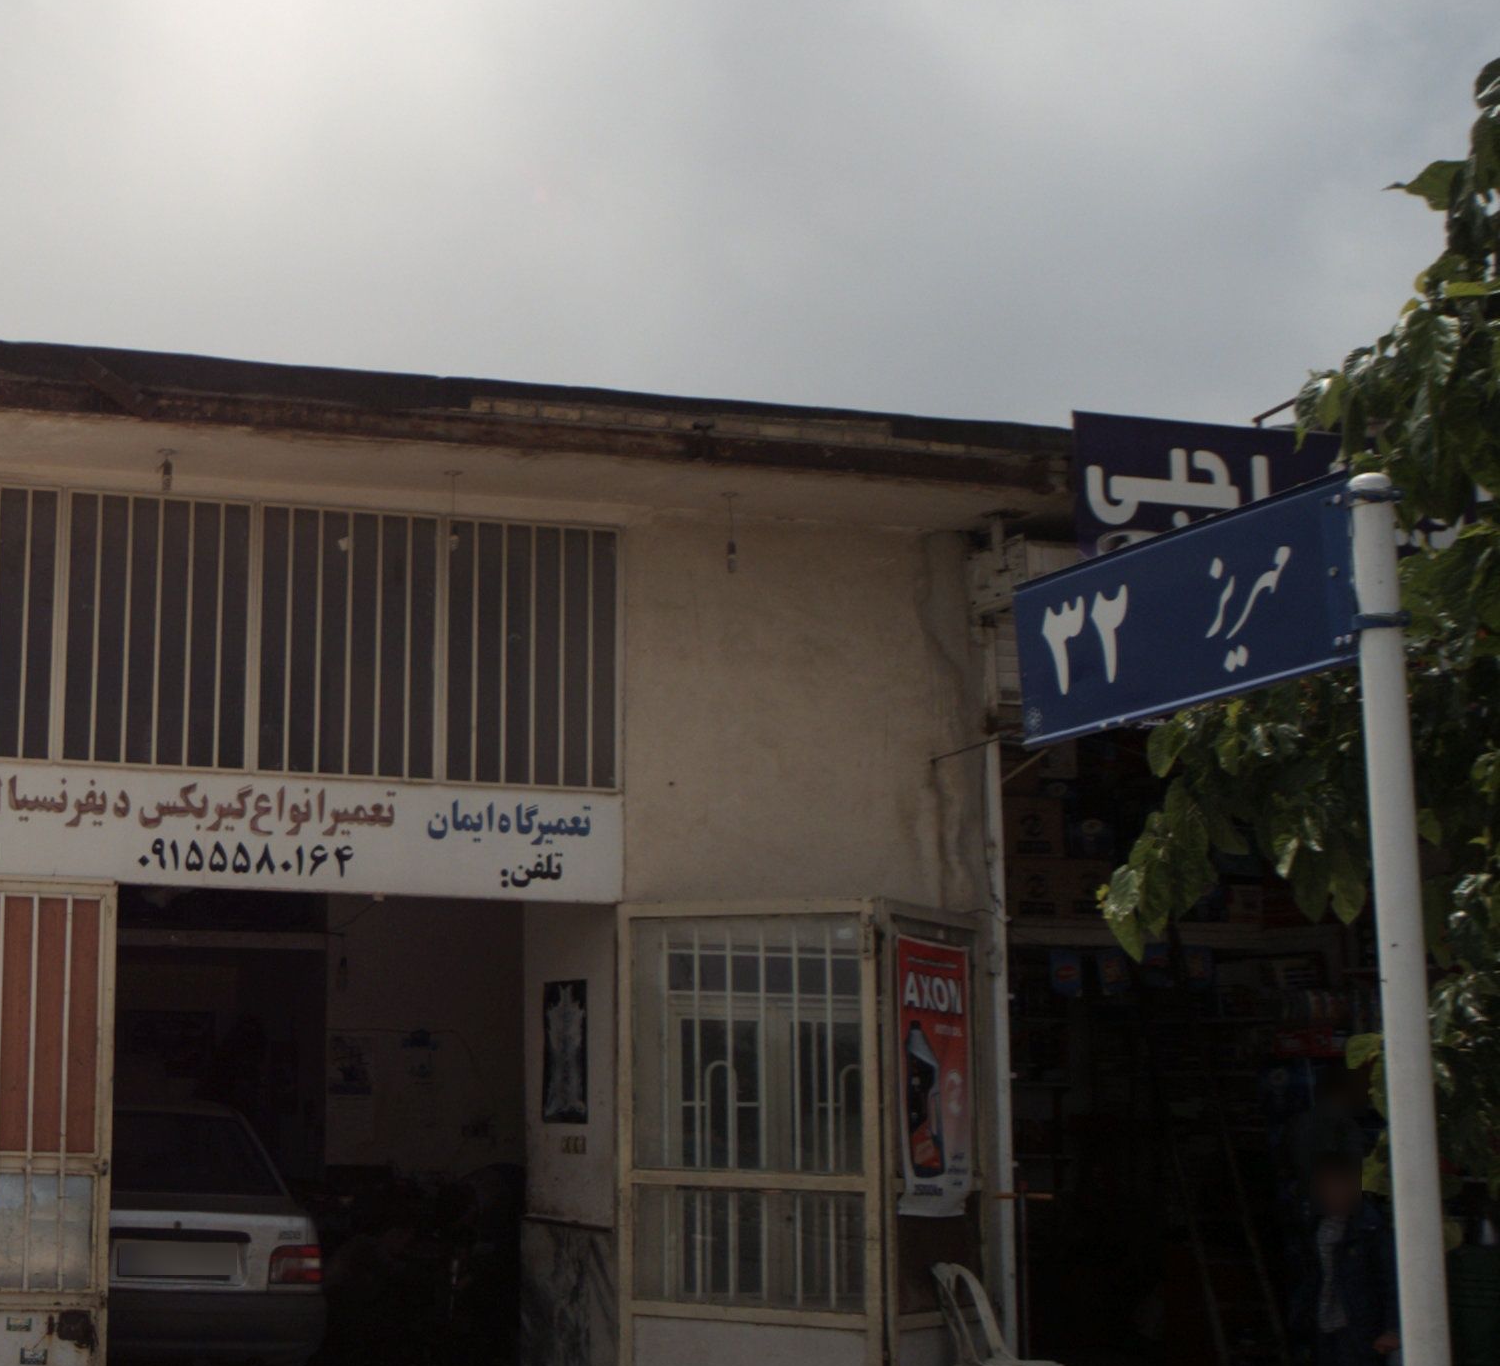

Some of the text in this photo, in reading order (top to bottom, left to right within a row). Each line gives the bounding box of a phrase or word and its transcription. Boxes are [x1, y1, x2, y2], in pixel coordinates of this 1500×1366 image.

[1041, 583, 1128, 696] ۳۲
[138, 782, 253, 832] گیربکس
[249, 786, 325, 836] انواع
[322, 790, 397, 836] تعمیر
[427, 799, 495, 843] ایمان
[498, 803, 592, 845] تعمیرگاه
[137, 837, 354, 877] ۰۹۱۵۵۵۸۰۱۶۴
[501, 852, 564, 888] تلفن:
[903, 969, 963, 1015] AXON
